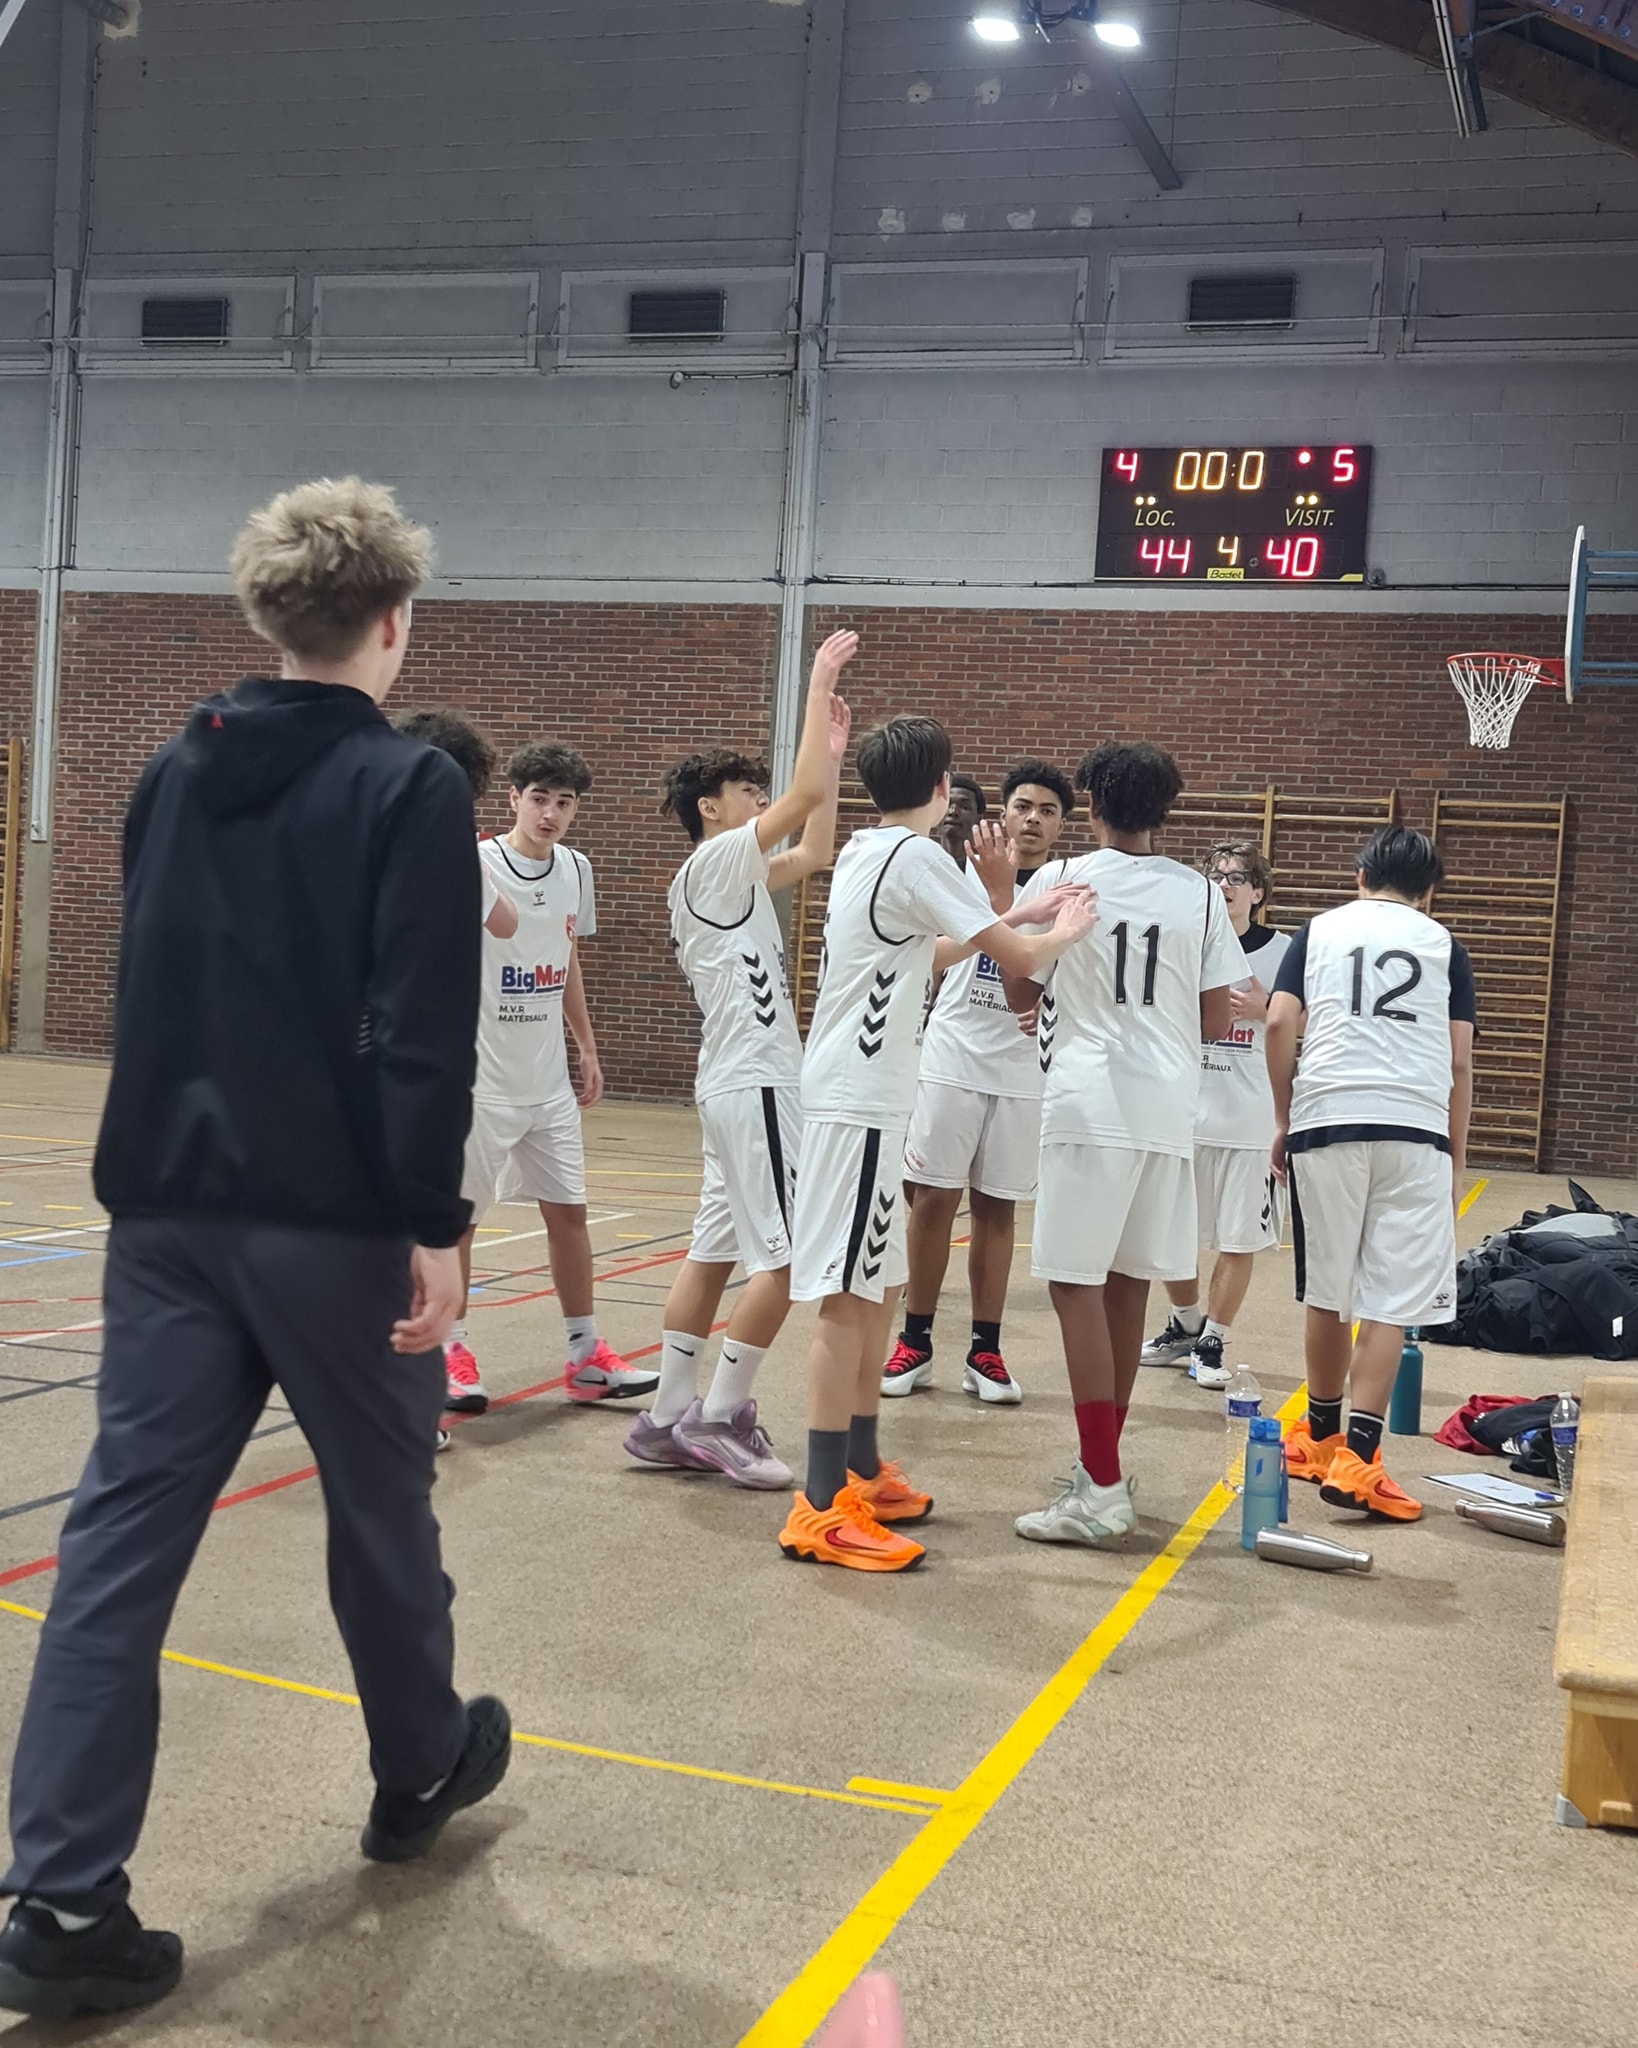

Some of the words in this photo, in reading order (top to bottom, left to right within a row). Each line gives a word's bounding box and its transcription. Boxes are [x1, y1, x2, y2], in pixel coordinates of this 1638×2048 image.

[1116, 451, 1138, 482] 4
[1174, 451, 1265, 490] 00:0
[1333, 448, 1355, 482] 5
[1134, 509, 1176, 527] LOC.
[1285, 509, 1335, 527] VISIT.
[1141, 539, 1192, 574] 44
[1218, 536, 1239, 566] 4
[1266, 538, 1319, 577] 40
[1106, 920, 1162, 1008] 11
[1347, 945, 1422, 1023] 12
